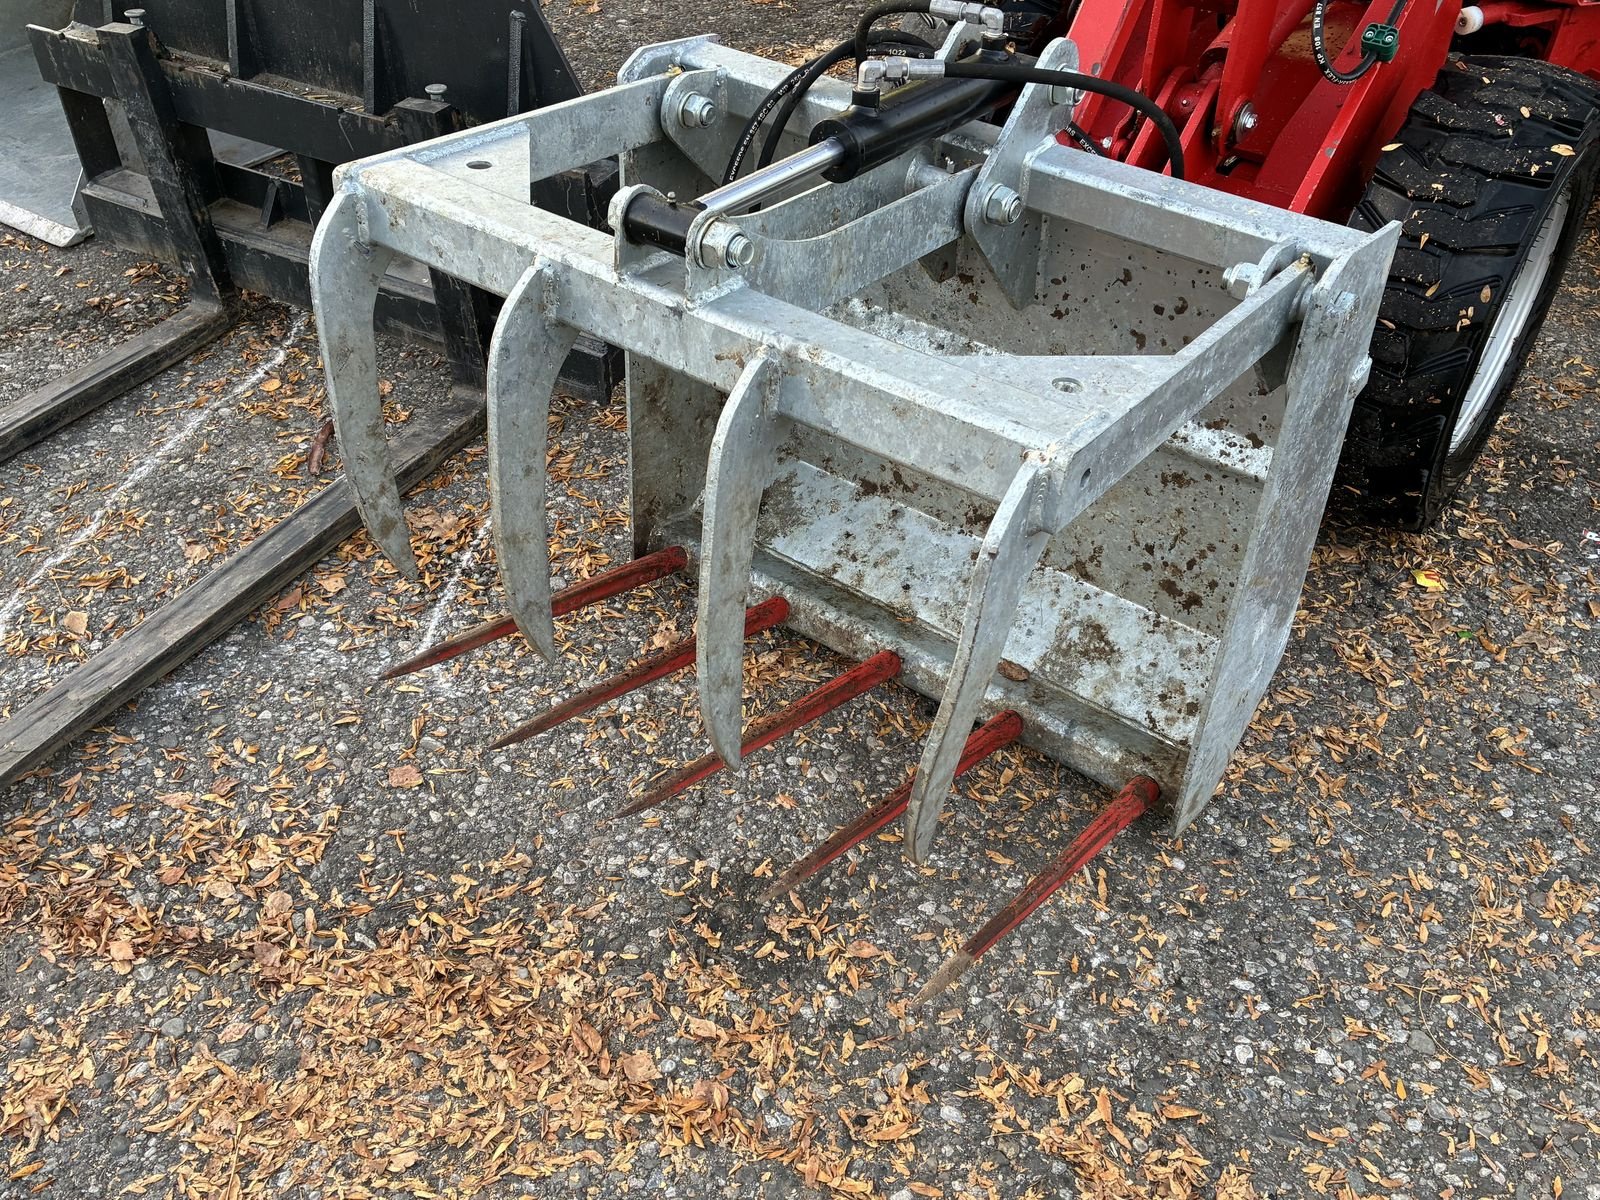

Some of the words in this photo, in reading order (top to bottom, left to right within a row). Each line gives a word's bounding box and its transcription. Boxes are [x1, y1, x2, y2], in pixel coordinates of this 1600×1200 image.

[1315, 2, 1323, 15] 857
[1313, 17, 1321, 29] EN
[1314, 36, 1322, 50] 108
[1316, 53, 1325, 65] KP
